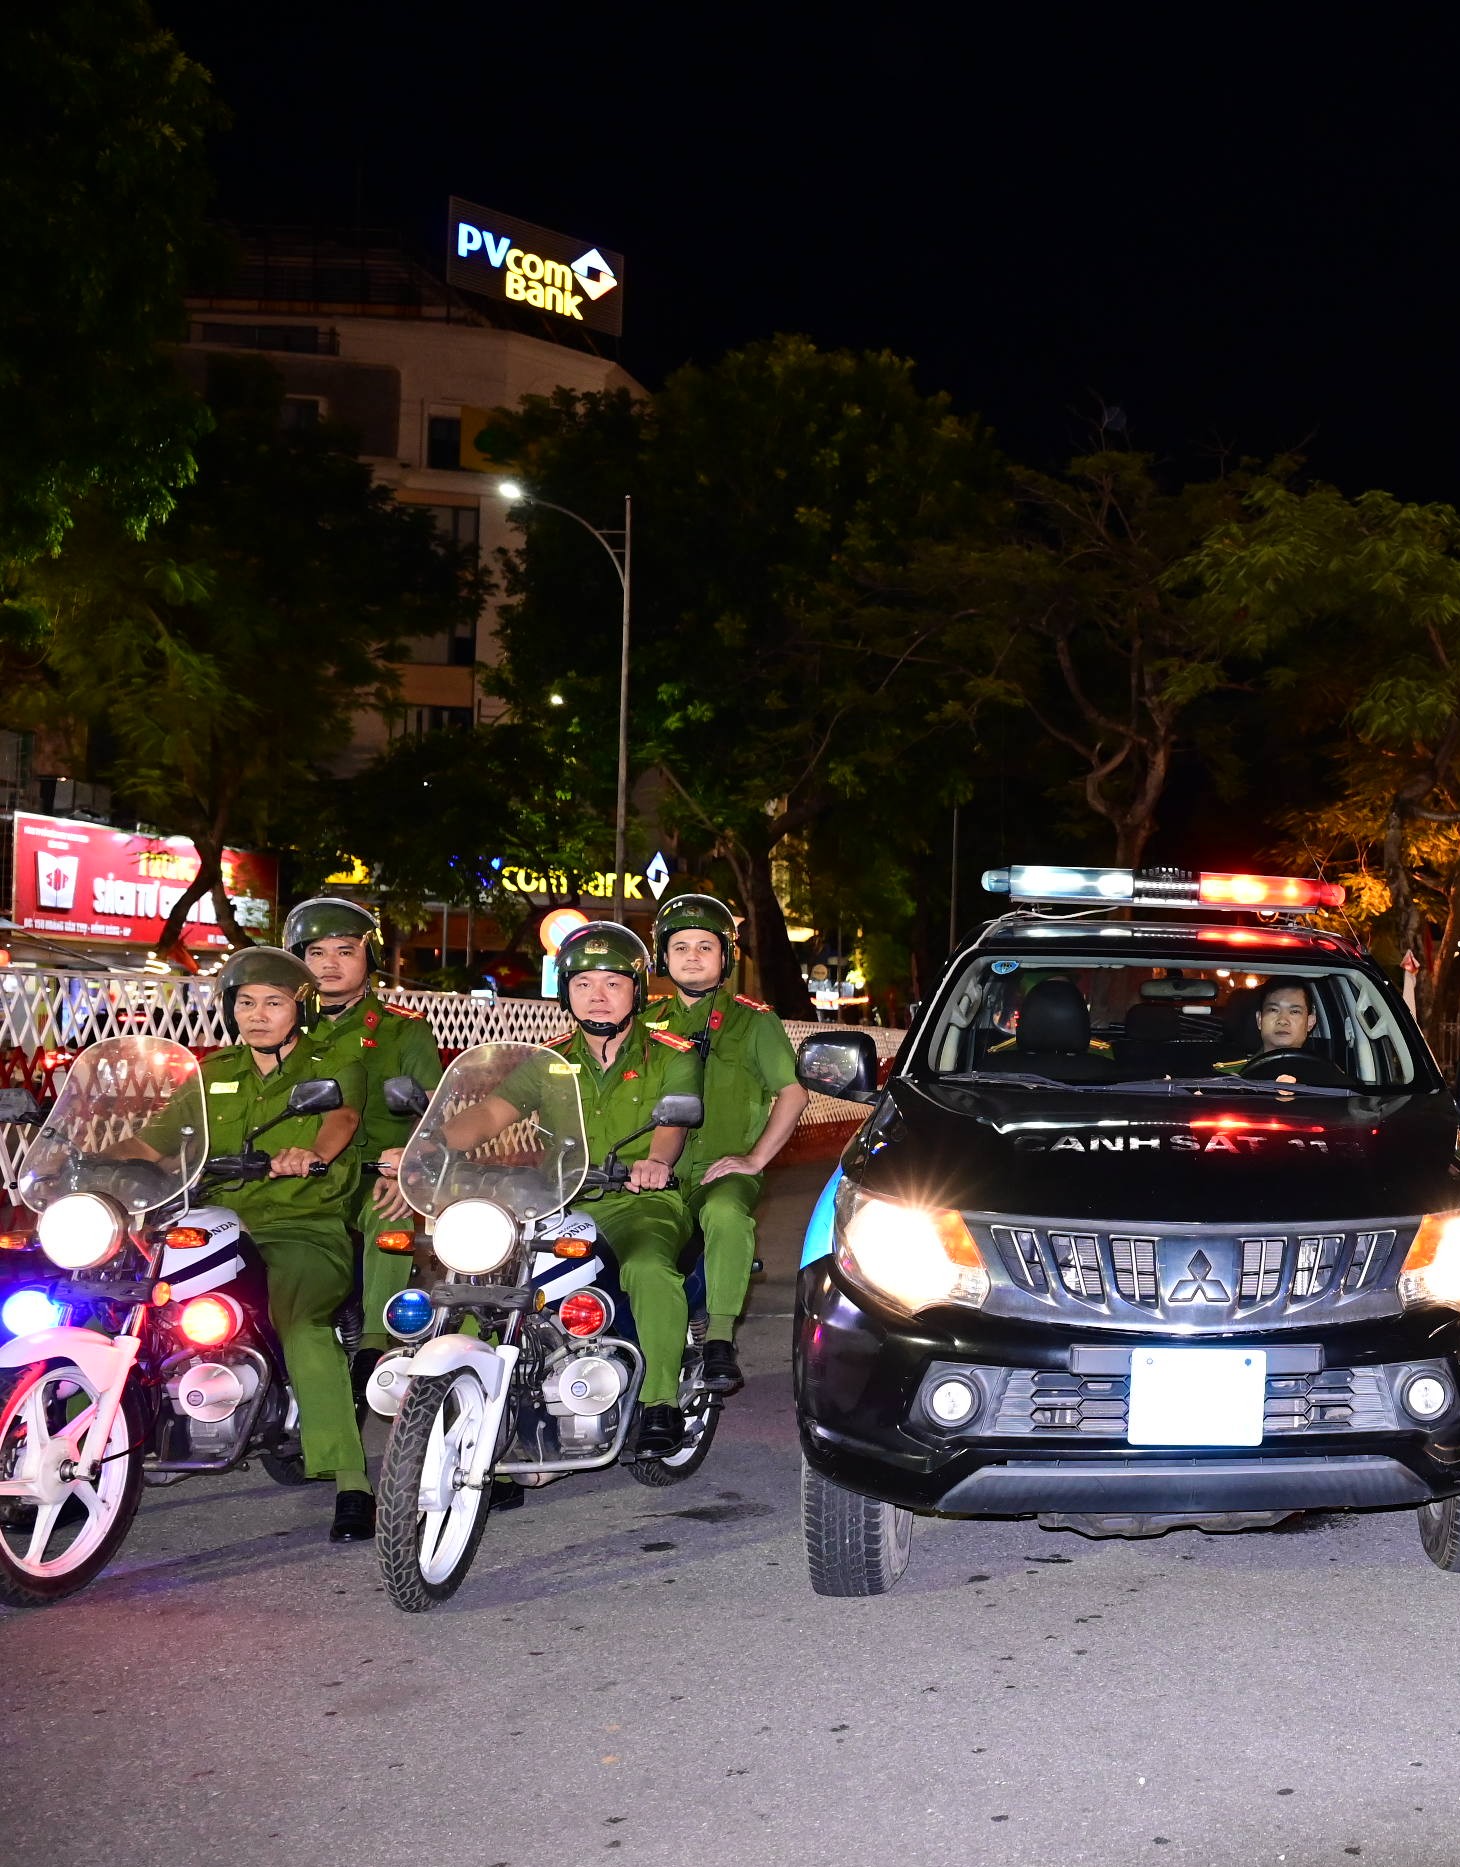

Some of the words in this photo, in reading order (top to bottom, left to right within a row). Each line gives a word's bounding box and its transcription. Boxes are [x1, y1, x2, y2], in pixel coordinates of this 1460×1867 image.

[458, 222, 573, 291] PVcom
[506, 270, 583, 320] Bank
[562, 1222, 594, 1238] ONDA
